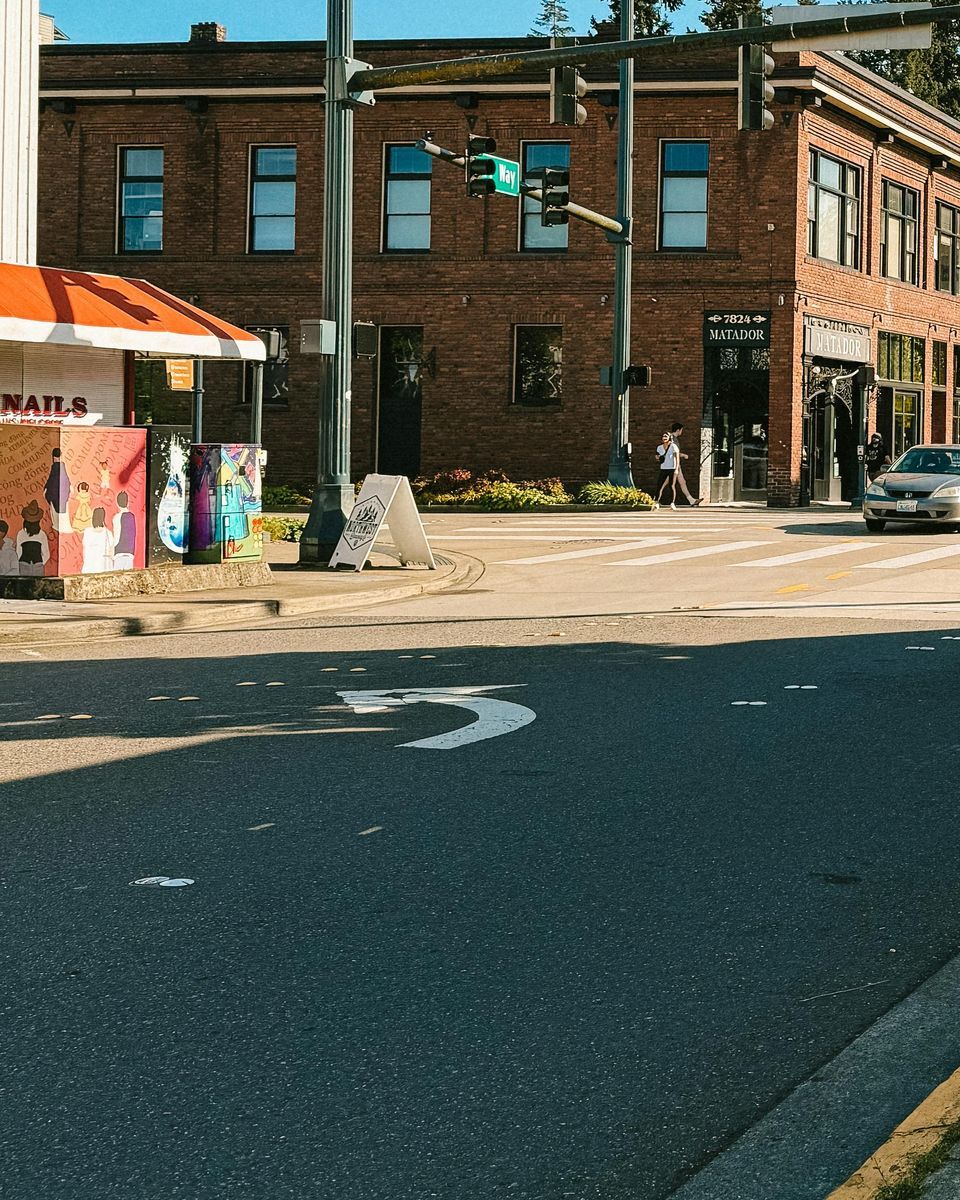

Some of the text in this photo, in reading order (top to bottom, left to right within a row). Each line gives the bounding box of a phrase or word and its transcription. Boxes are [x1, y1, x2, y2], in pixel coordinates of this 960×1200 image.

[499, 163, 516, 190] Way
[723, 314, 752, 324] 7824
[709, 329, 765, 341] MATADOR
[816, 332, 862, 358] MATADOR
[0, 393, 89, 418] NAILS
[8, 440, 52, 475] COMMUNITY
